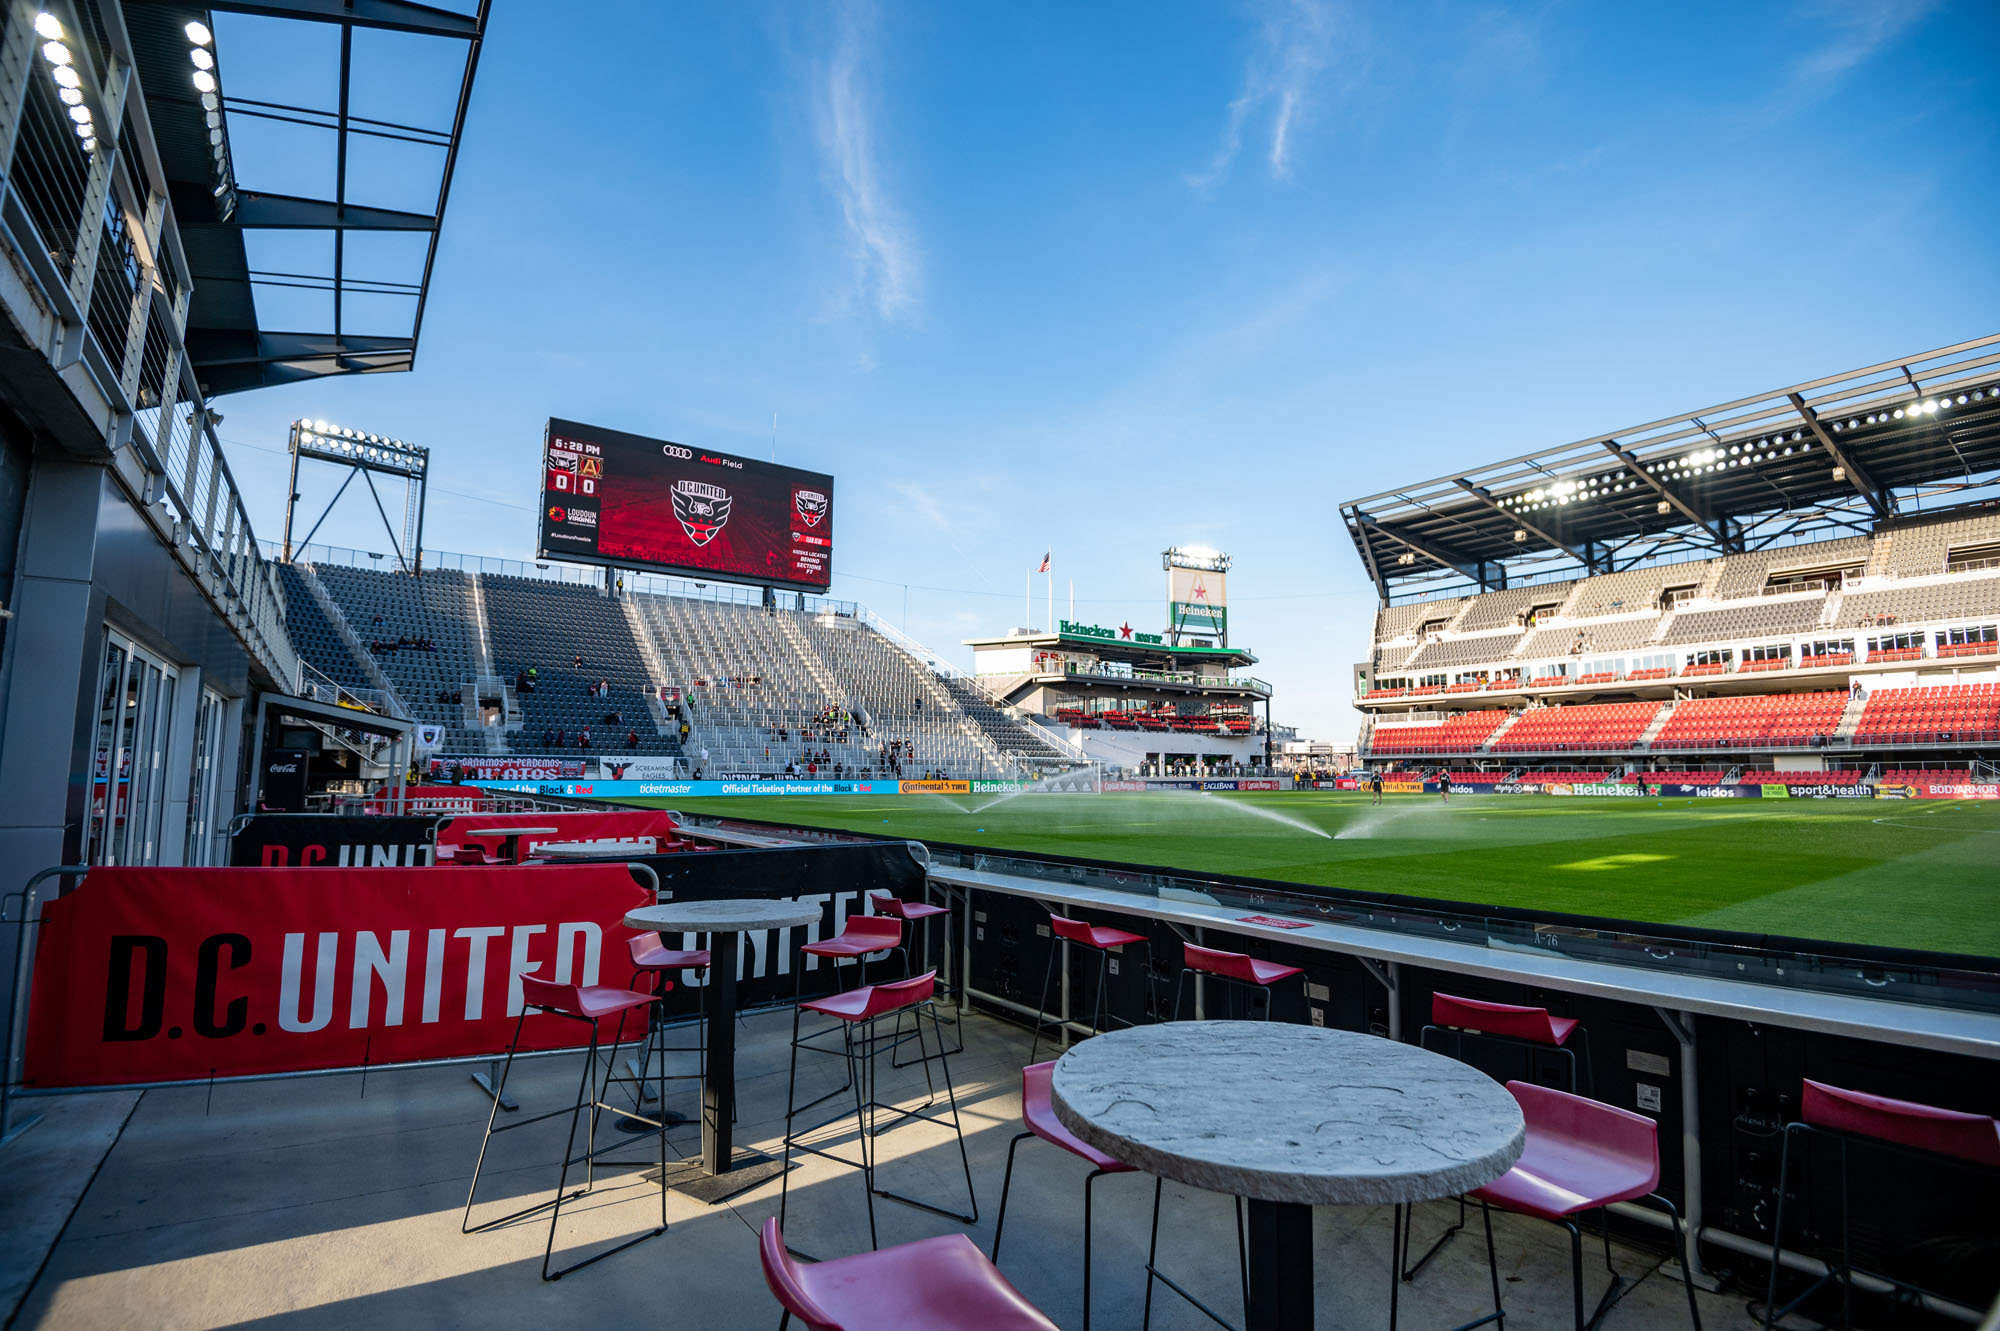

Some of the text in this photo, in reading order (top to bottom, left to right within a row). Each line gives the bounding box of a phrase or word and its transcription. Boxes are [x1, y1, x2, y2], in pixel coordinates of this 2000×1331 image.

[556, 439, 583, 451] 6:28
[586, 444, 600, 455] PM
[700, 455, 743, 469] Audi Field
[556, 475, 567, 489] 0
[584, 479, 594, 494] 0
[1178, 604, 1224, 618] Heineken
[1059, 620, 1116, 639] Heineken
[540, 785, 565, 794] Black
[566, 785, 573, 794] &
[575, 785, 593, 794] Red
[640, 783, 692, 793] ticketmaster
[722, 784, 750, 793] Official
[752, 784, 785, 795] Ticketing
[786, 784, 812, 792] Partner
[813, 784, 821, 792] of
[822, 784, 833, 792] the
[834, 784, 852, 792] Black
[859, 784, 872, 792] Red
[902, 782, 944, 792] Continental
[973, 781, 1021, 793] Heineken
[1696, 786, 1735, 797] leidos
[1790, 784, 1871, 797] sport&health
[1929, 784, 1998, 794] BODYARMOR
[1534, 932, 1558, 946] A-76
[278, 921, 602, 1033] UNITED
